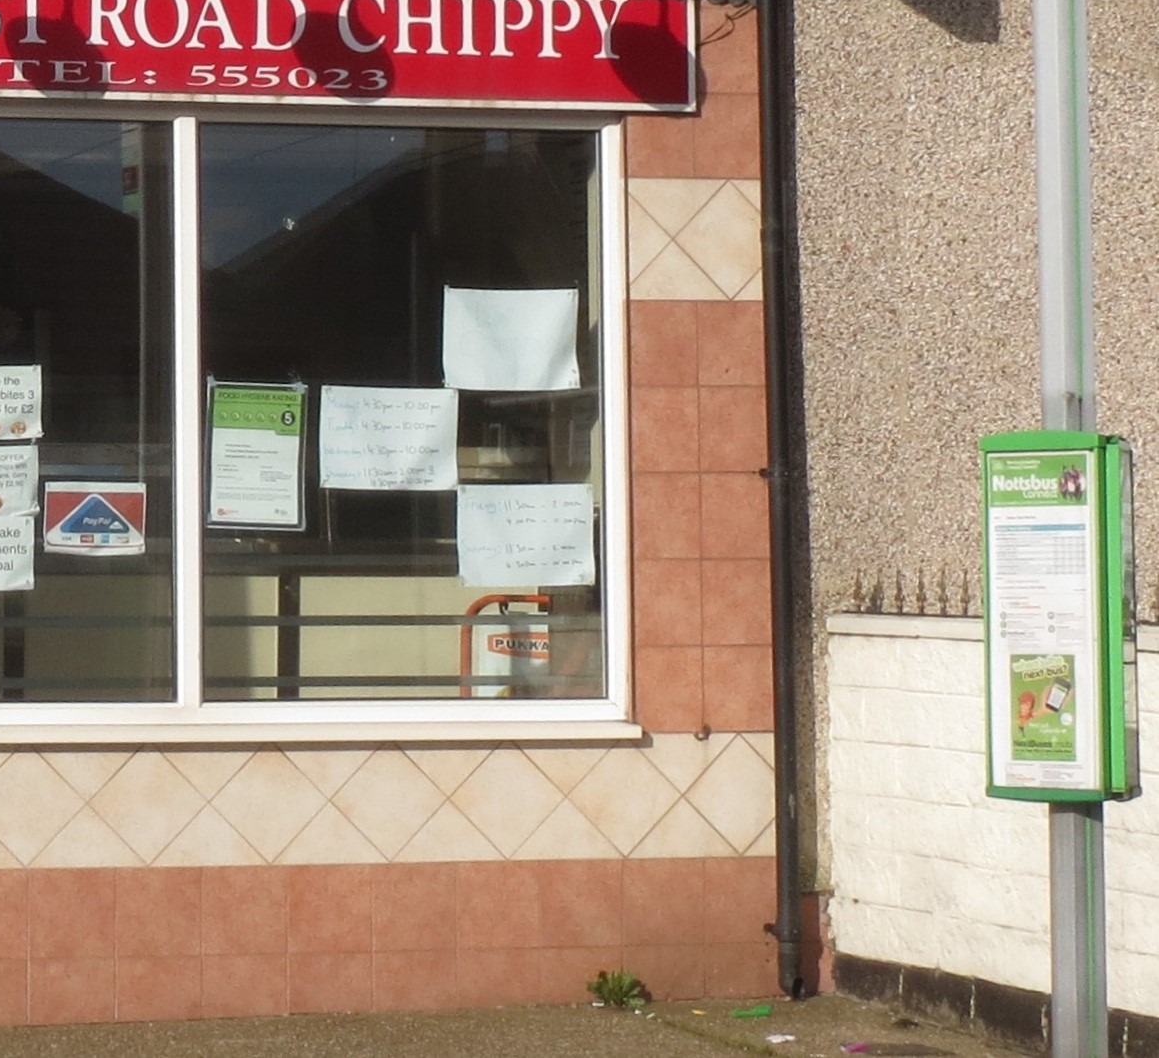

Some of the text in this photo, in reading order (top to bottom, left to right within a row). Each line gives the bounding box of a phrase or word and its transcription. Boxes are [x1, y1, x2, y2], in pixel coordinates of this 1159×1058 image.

[186, 63, 388, 91] 555023
[4, 376, 20, 386] the
[0, 390, 25, 400] bites
[27, 389, 35, 400] 3
[4, 403, 18, 414] for
[21, 404, 34, 414] £2
[284, 412, 293, 424] 5
[0, 453, 24, 461] OFFER
[992, 473, 1059, 491] Nottsbus
[83, 517, 112, 526] PayPal
[495, 638, 549, 651] PUKKA
[1023, 670, 1044, 680] next
[1046, 664, 1069, 676] bus?
